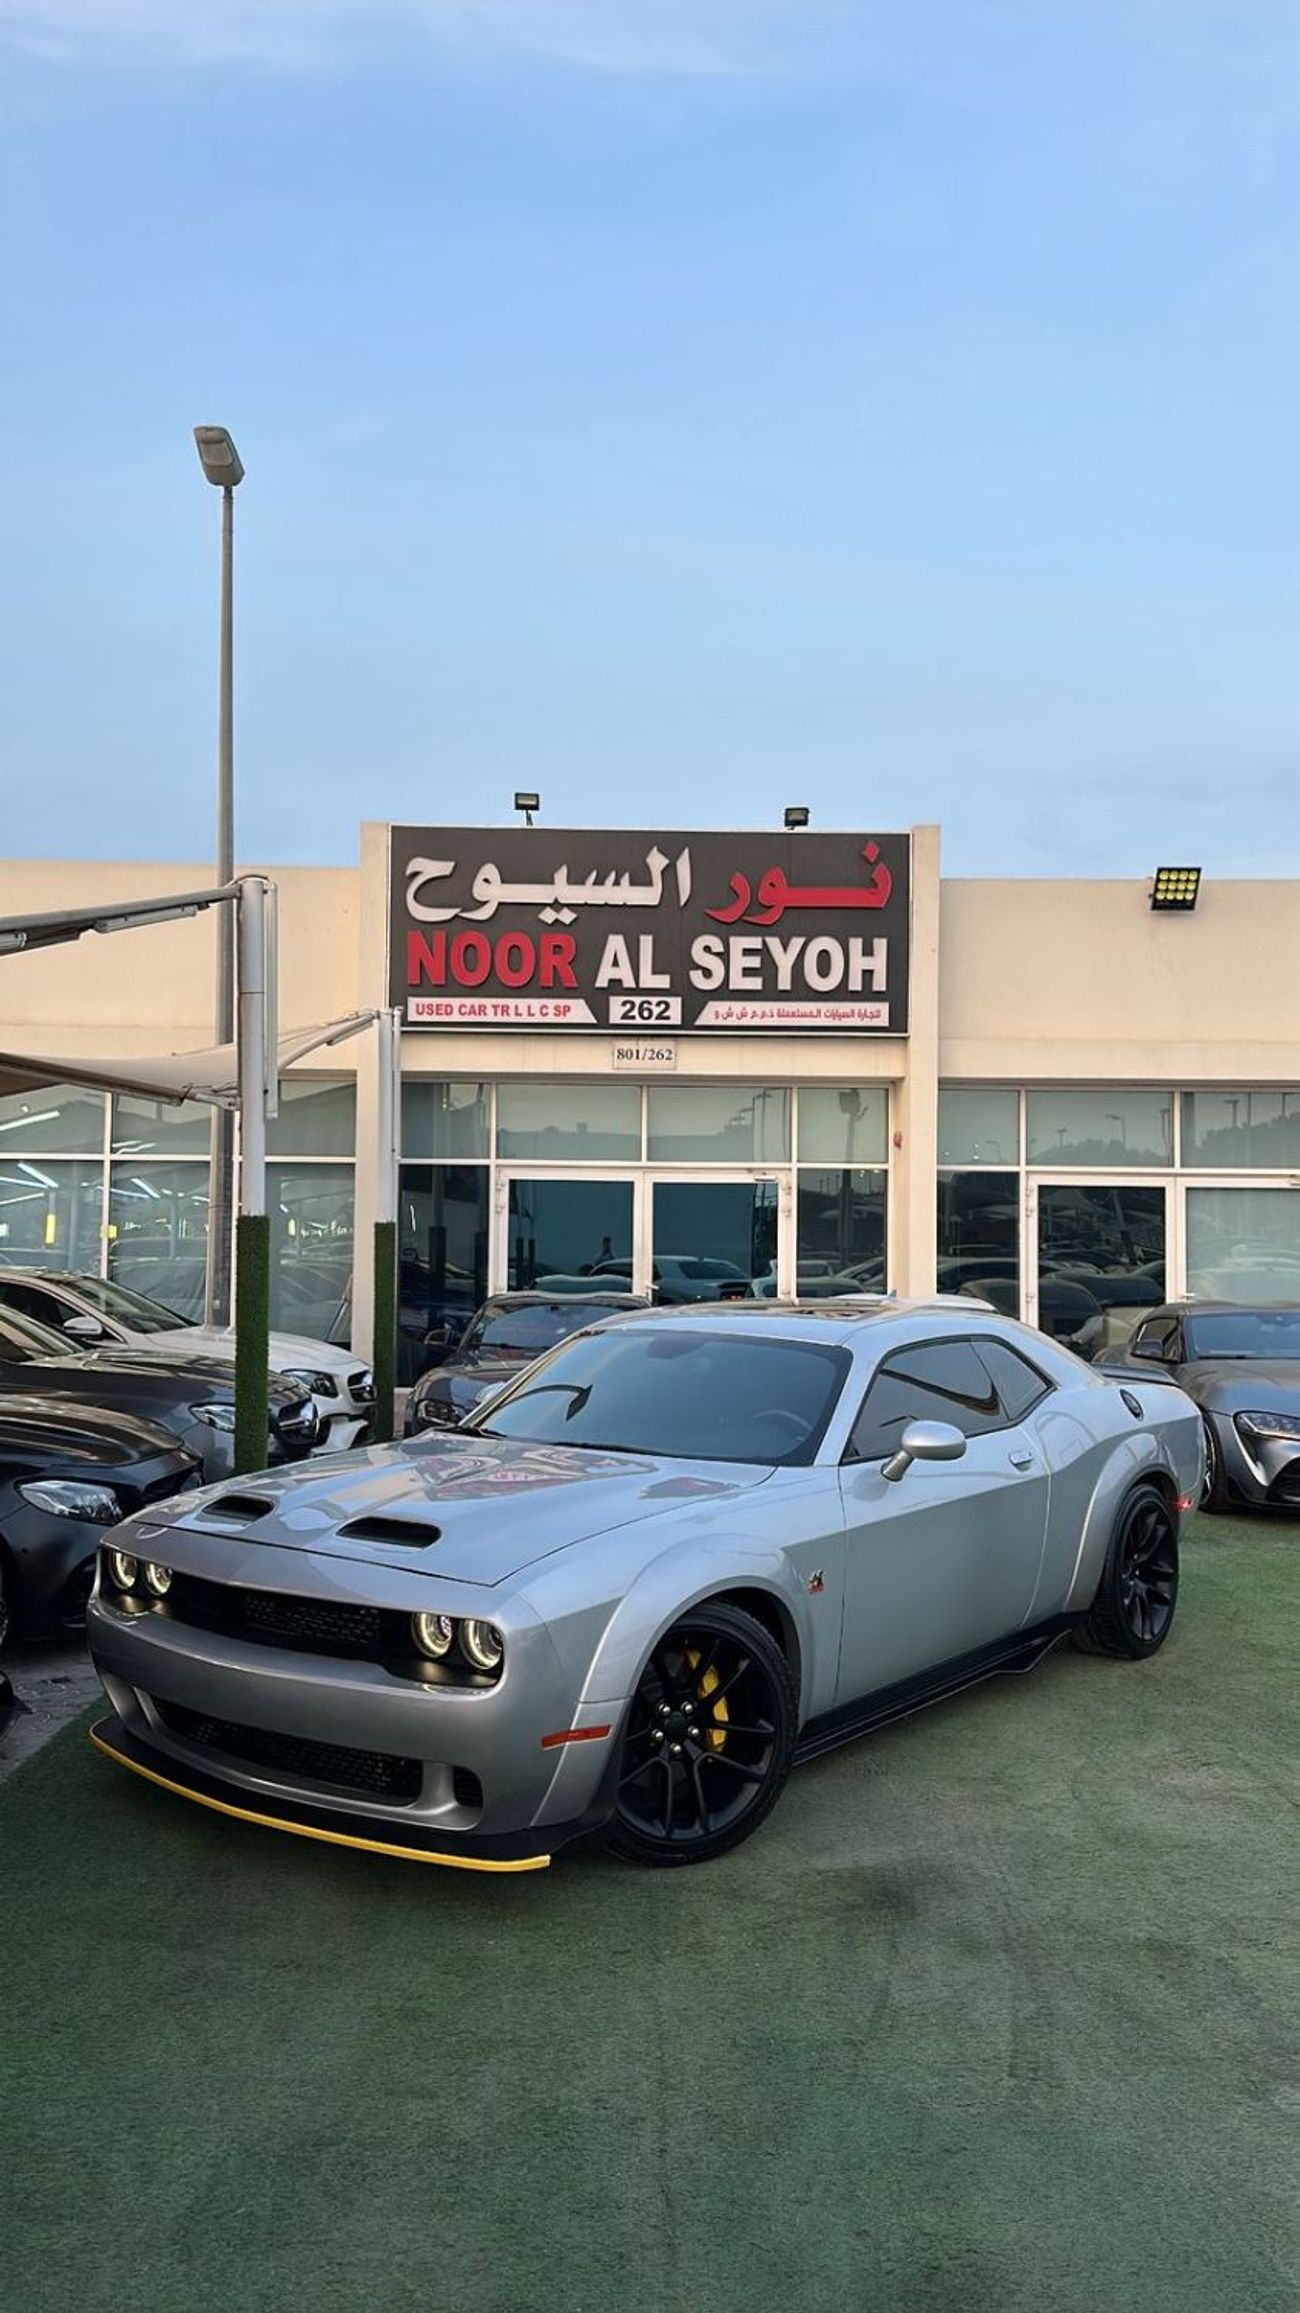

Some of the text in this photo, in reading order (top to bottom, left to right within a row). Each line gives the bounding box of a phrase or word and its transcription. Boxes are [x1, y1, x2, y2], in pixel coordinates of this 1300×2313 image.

[405, 841, 892, 925] نور السيوح
[407, 930, 888, 992] NOOR AL SEYOH
[415, 1003, 571, 1018] USED CAR TR L L C SP
[620, 1000, 671, 1020] 262
[616, 1048, 673, 1061] 801/262
